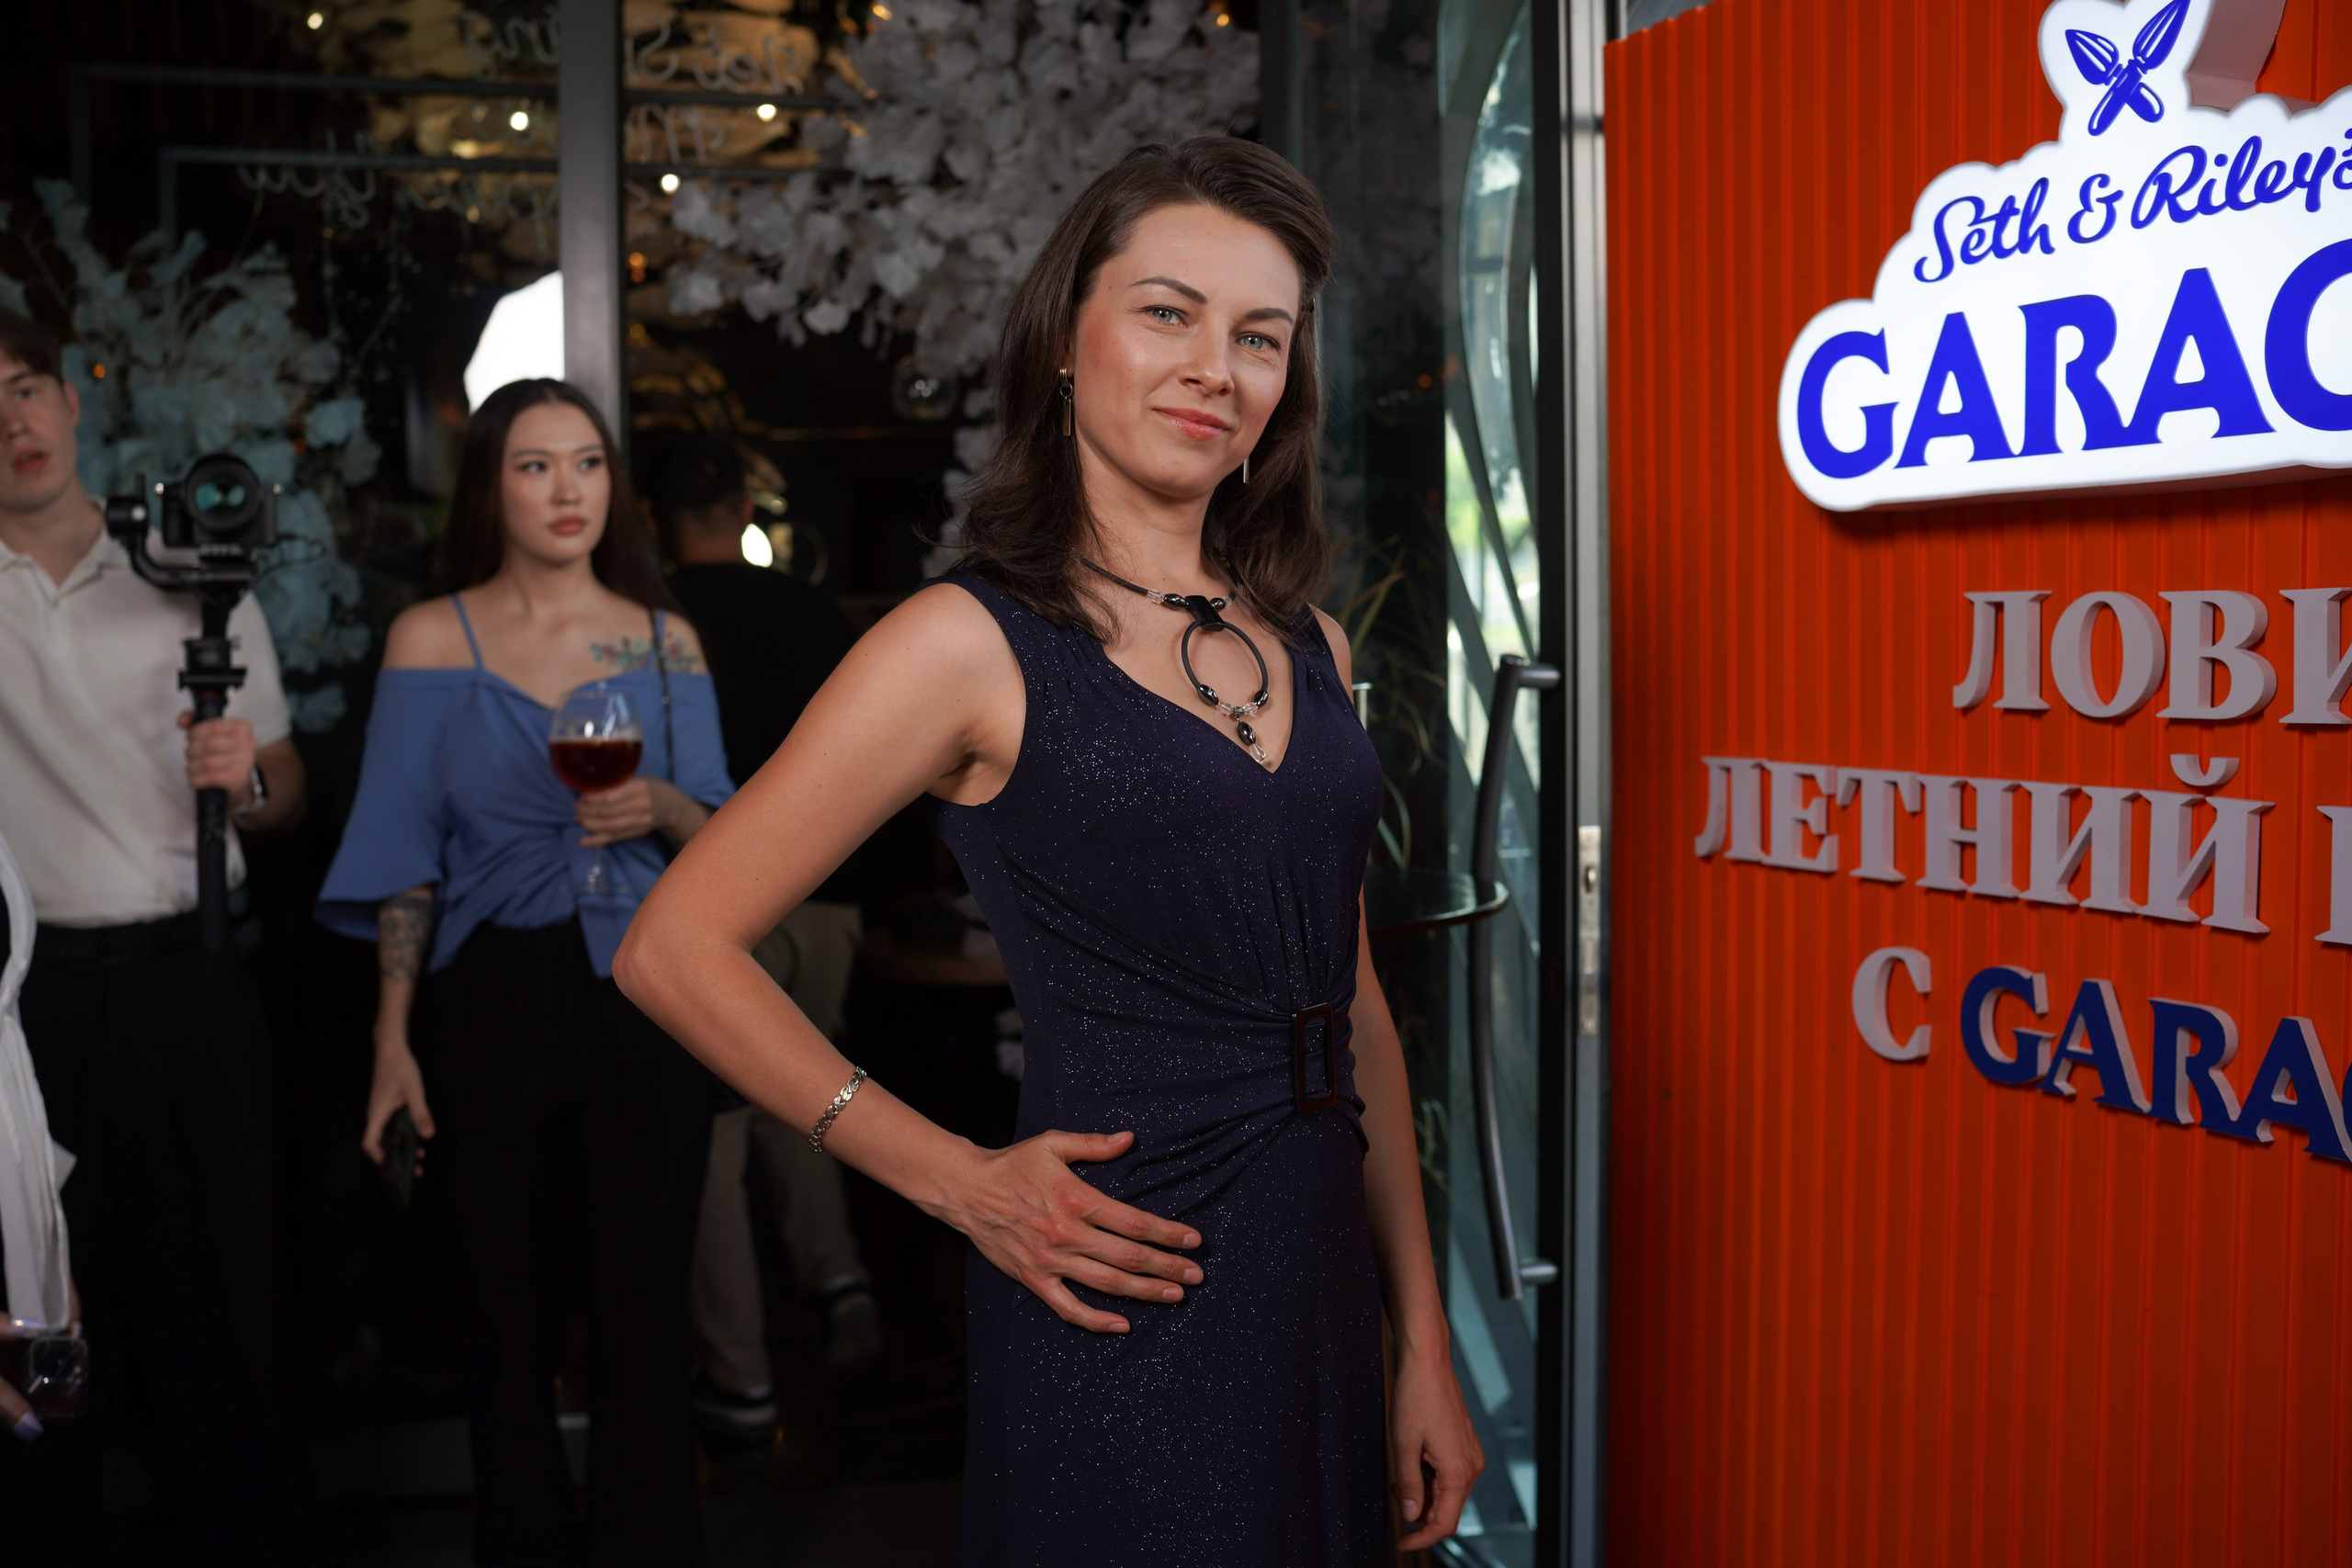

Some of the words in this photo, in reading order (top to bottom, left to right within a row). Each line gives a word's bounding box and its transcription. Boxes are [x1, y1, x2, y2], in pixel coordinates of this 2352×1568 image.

[1914, 177, 2056, 284] Seth
[2067, 173, 2124, 244] &
[1695, 753, 2276, 934] ЛЕТНИЙ
[1961, 964, 2352, 1163] GARA
